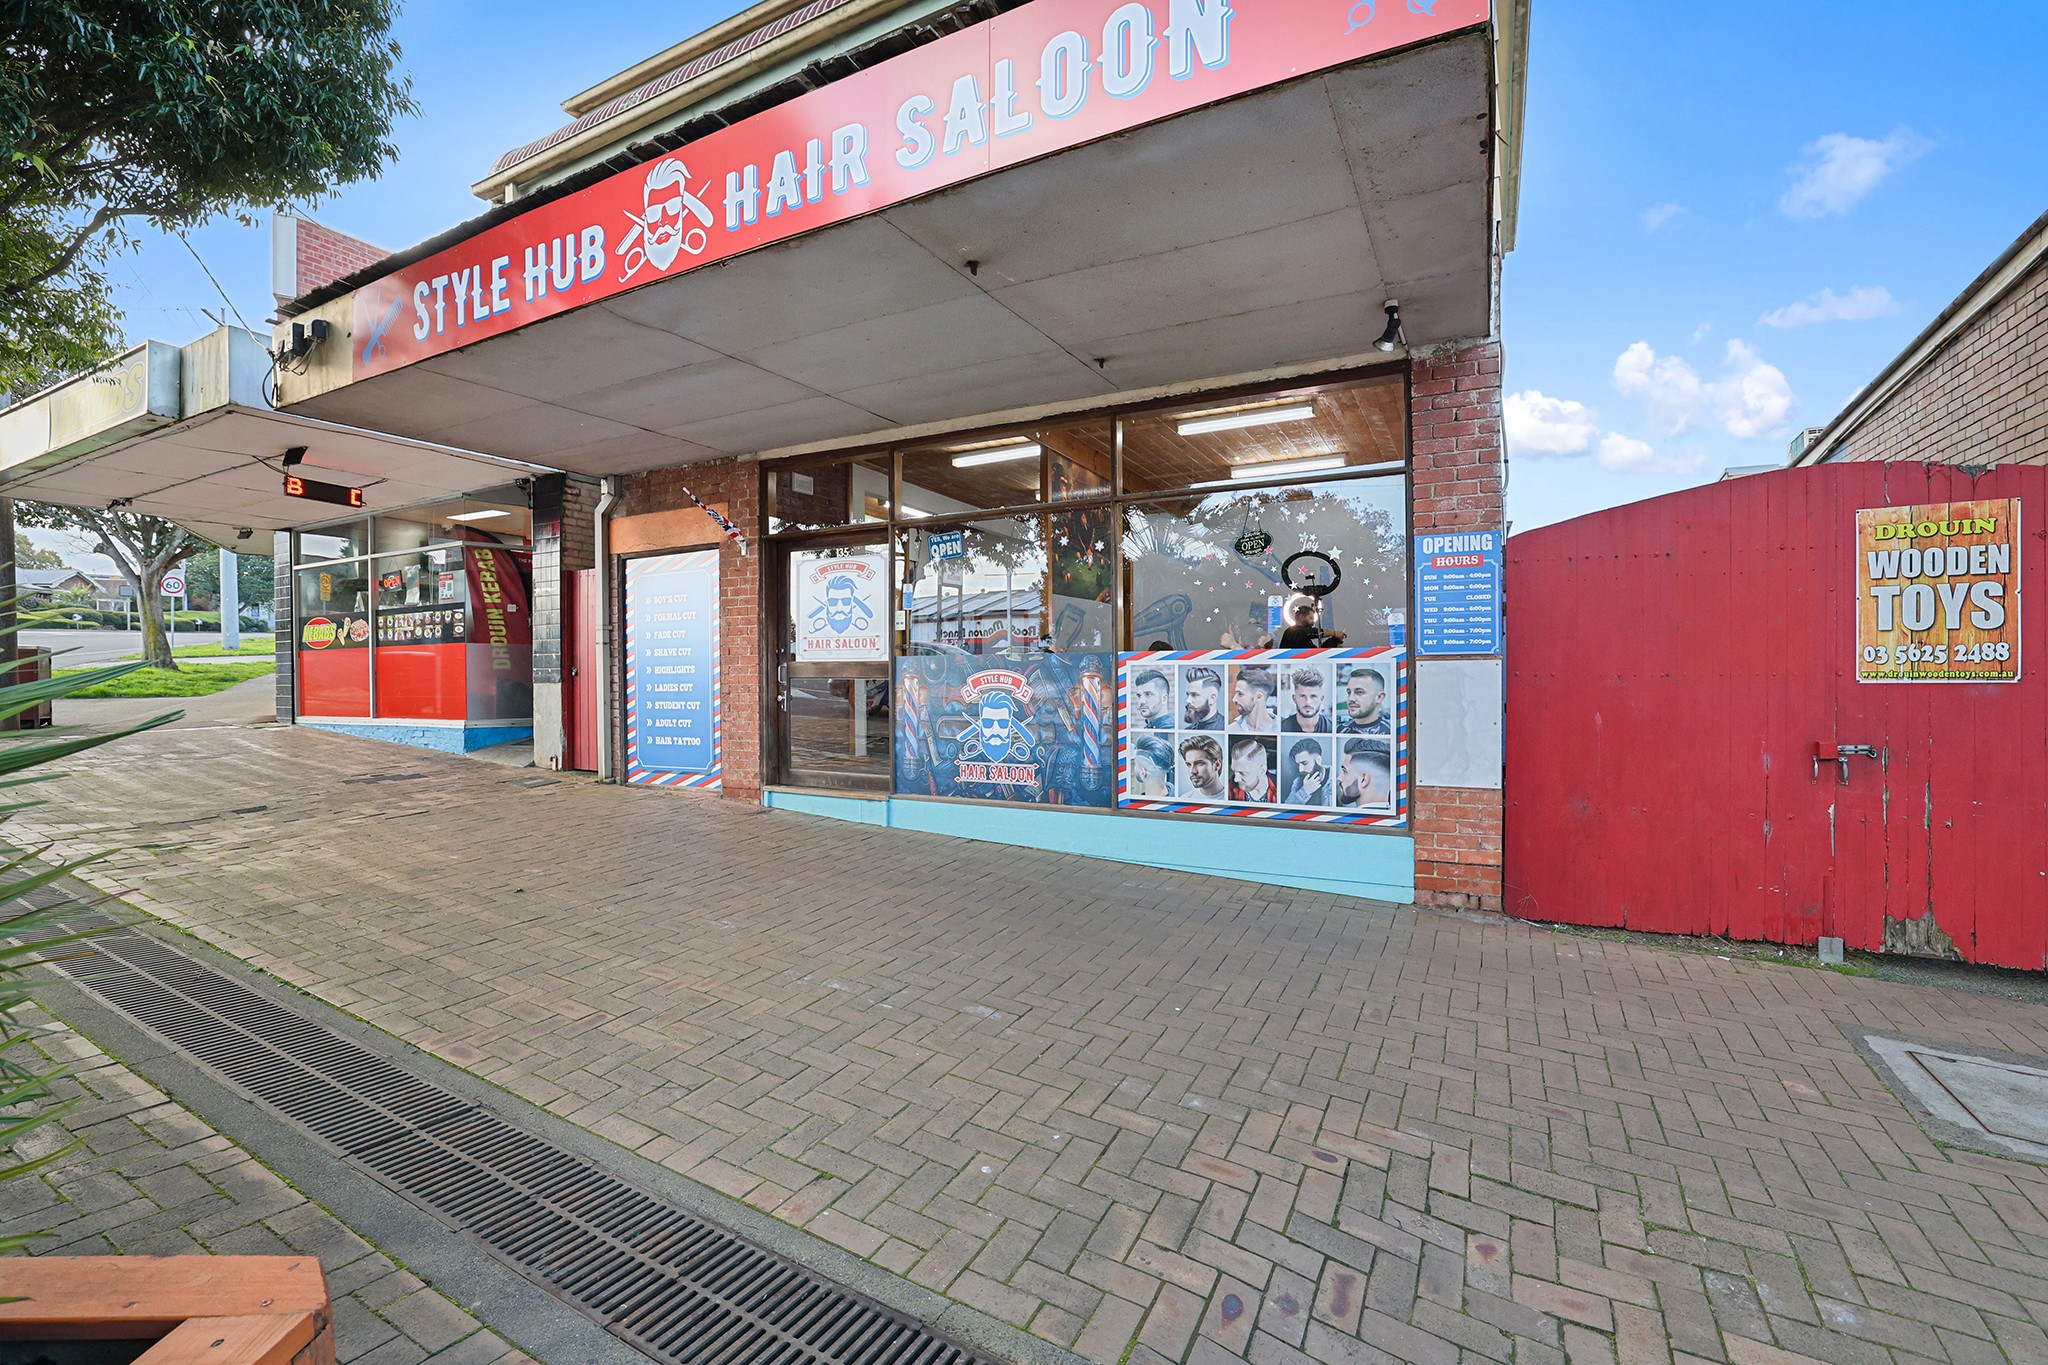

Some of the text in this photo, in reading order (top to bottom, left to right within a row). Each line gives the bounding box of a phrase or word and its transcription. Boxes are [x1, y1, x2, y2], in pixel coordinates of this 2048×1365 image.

[413, 0, 1237, 342] STYLE HUB HAIR SALOON
[1874, 517, 1997, 540] DROUIN
[931, 540, 961, 557] OPEN
[1241, 538, 1265, 551] OPEN
[1300, 537, 1319, 553] Joy
[1422, 533, 1493, 554] OPENING
[835, 548, 848, 557] 135
[827, 562, 857, 571] STYLE HUB
[1436, 555, 1479, 567] HOURS
[1866, 543, 2010, 580] WOODEN
[165, 581, 180, 589] 60
[383, 575, 401, 588] OPEN
[653, 594, 687, 604] BOY'S CUT
[475, 548, 513, 670] DROUIN KEBAB
[1869, 580, 2005, 631] TOYS
[653, 611, 696, 621] FORMAL CUT
[302, 623, 337, 642] KEBABS
[653, 630, 686, 639] FADE CUT
[807, 638, 876, 649] HAIR SALOON
[653, 647, 692, 656] SHAVE CUT
[1863, 642, 2010, 664] 03 5625 2488
[654, 665, 695, 674] HIGHLIGHTS
[1861, 670, 2014, 679] www.drouinwoodentoys.com.au
[980, 674, 1013, 685] STYLE HUB
[654, 683, 693, 692] LADIES CUT
[654, 701, 700, 709] STUDENT CUT
[655, 719, 692, 727] ADULT CUT
[655, 736, 701, 745] HAIR TATTOO
[960, 764, 1035, 781] HAIR SALOON
